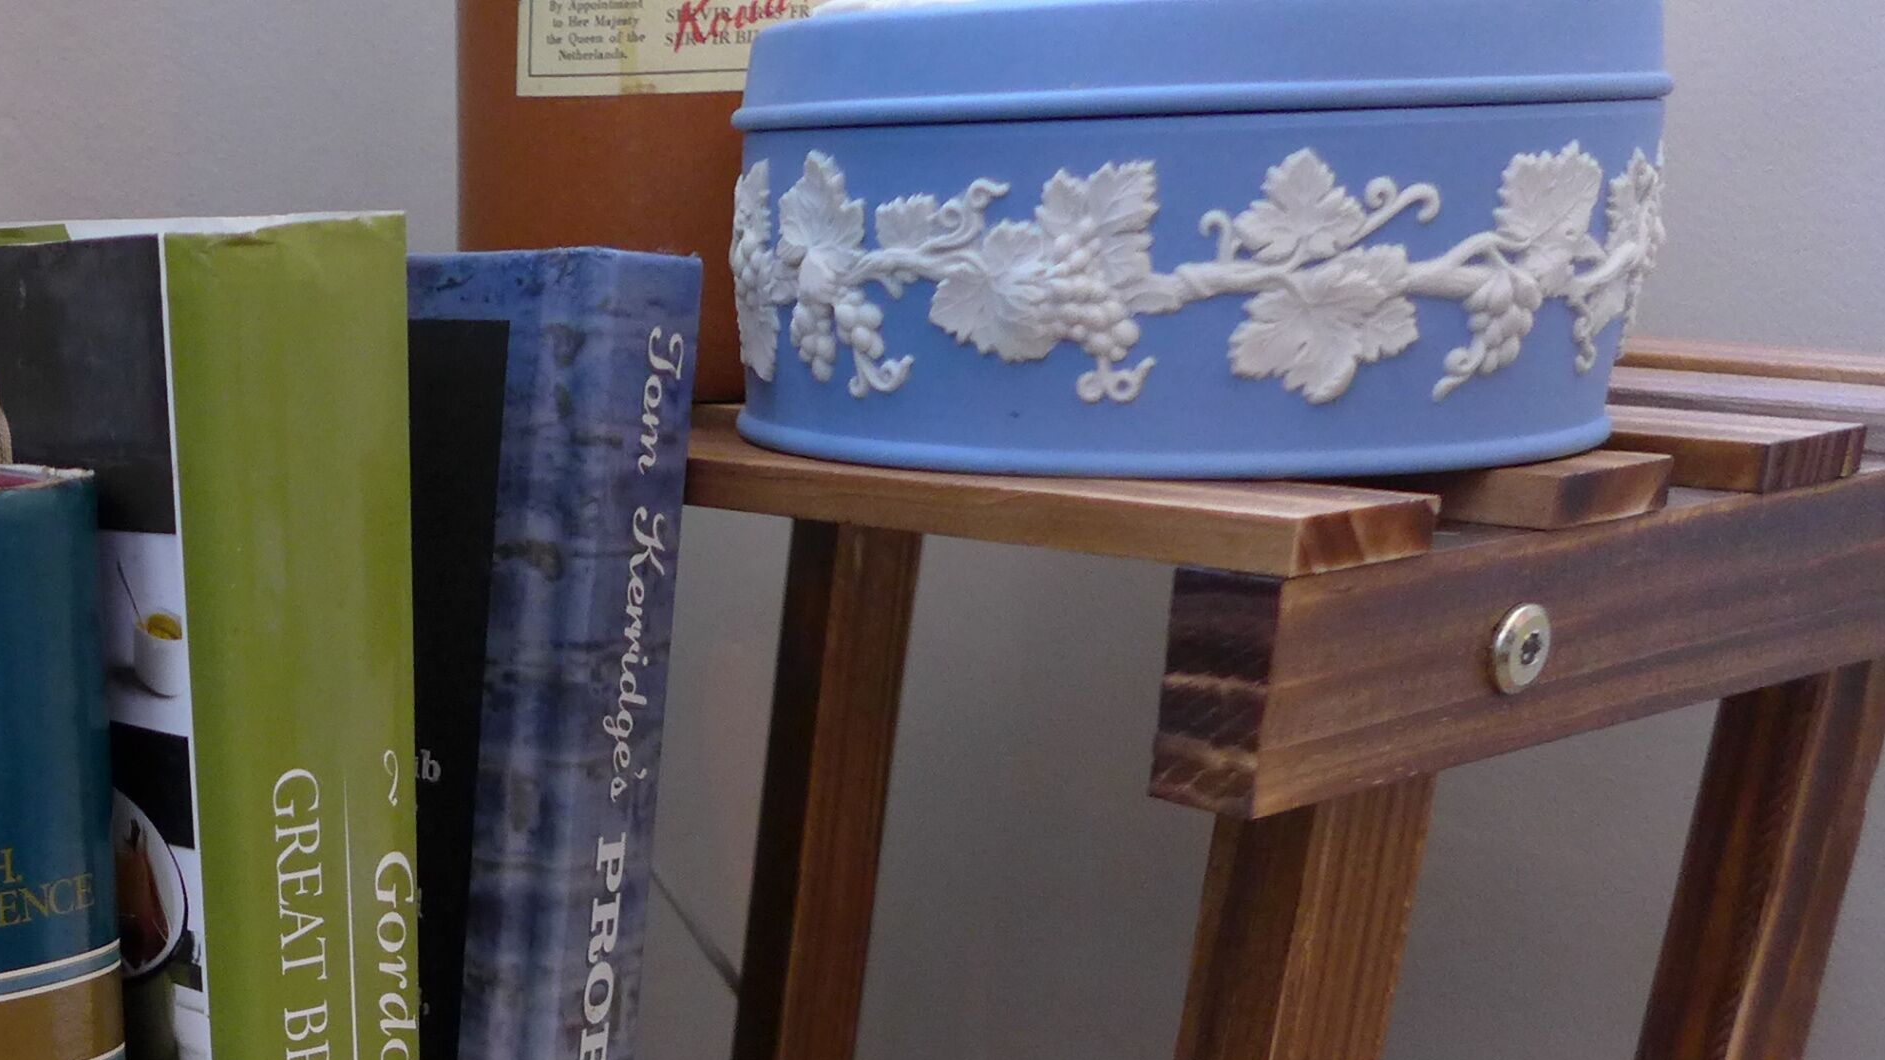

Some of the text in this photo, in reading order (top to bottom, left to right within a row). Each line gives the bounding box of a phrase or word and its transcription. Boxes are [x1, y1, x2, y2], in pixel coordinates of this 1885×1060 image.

[546, 32, 646, 47] the Queen of the
[552, 15, 640, 30] to Her Majesty
[639, 325, 684, 475] Tom
[602, 506, 666, 803] Kerridge's
[272, 767, 329, 981] GREAT
